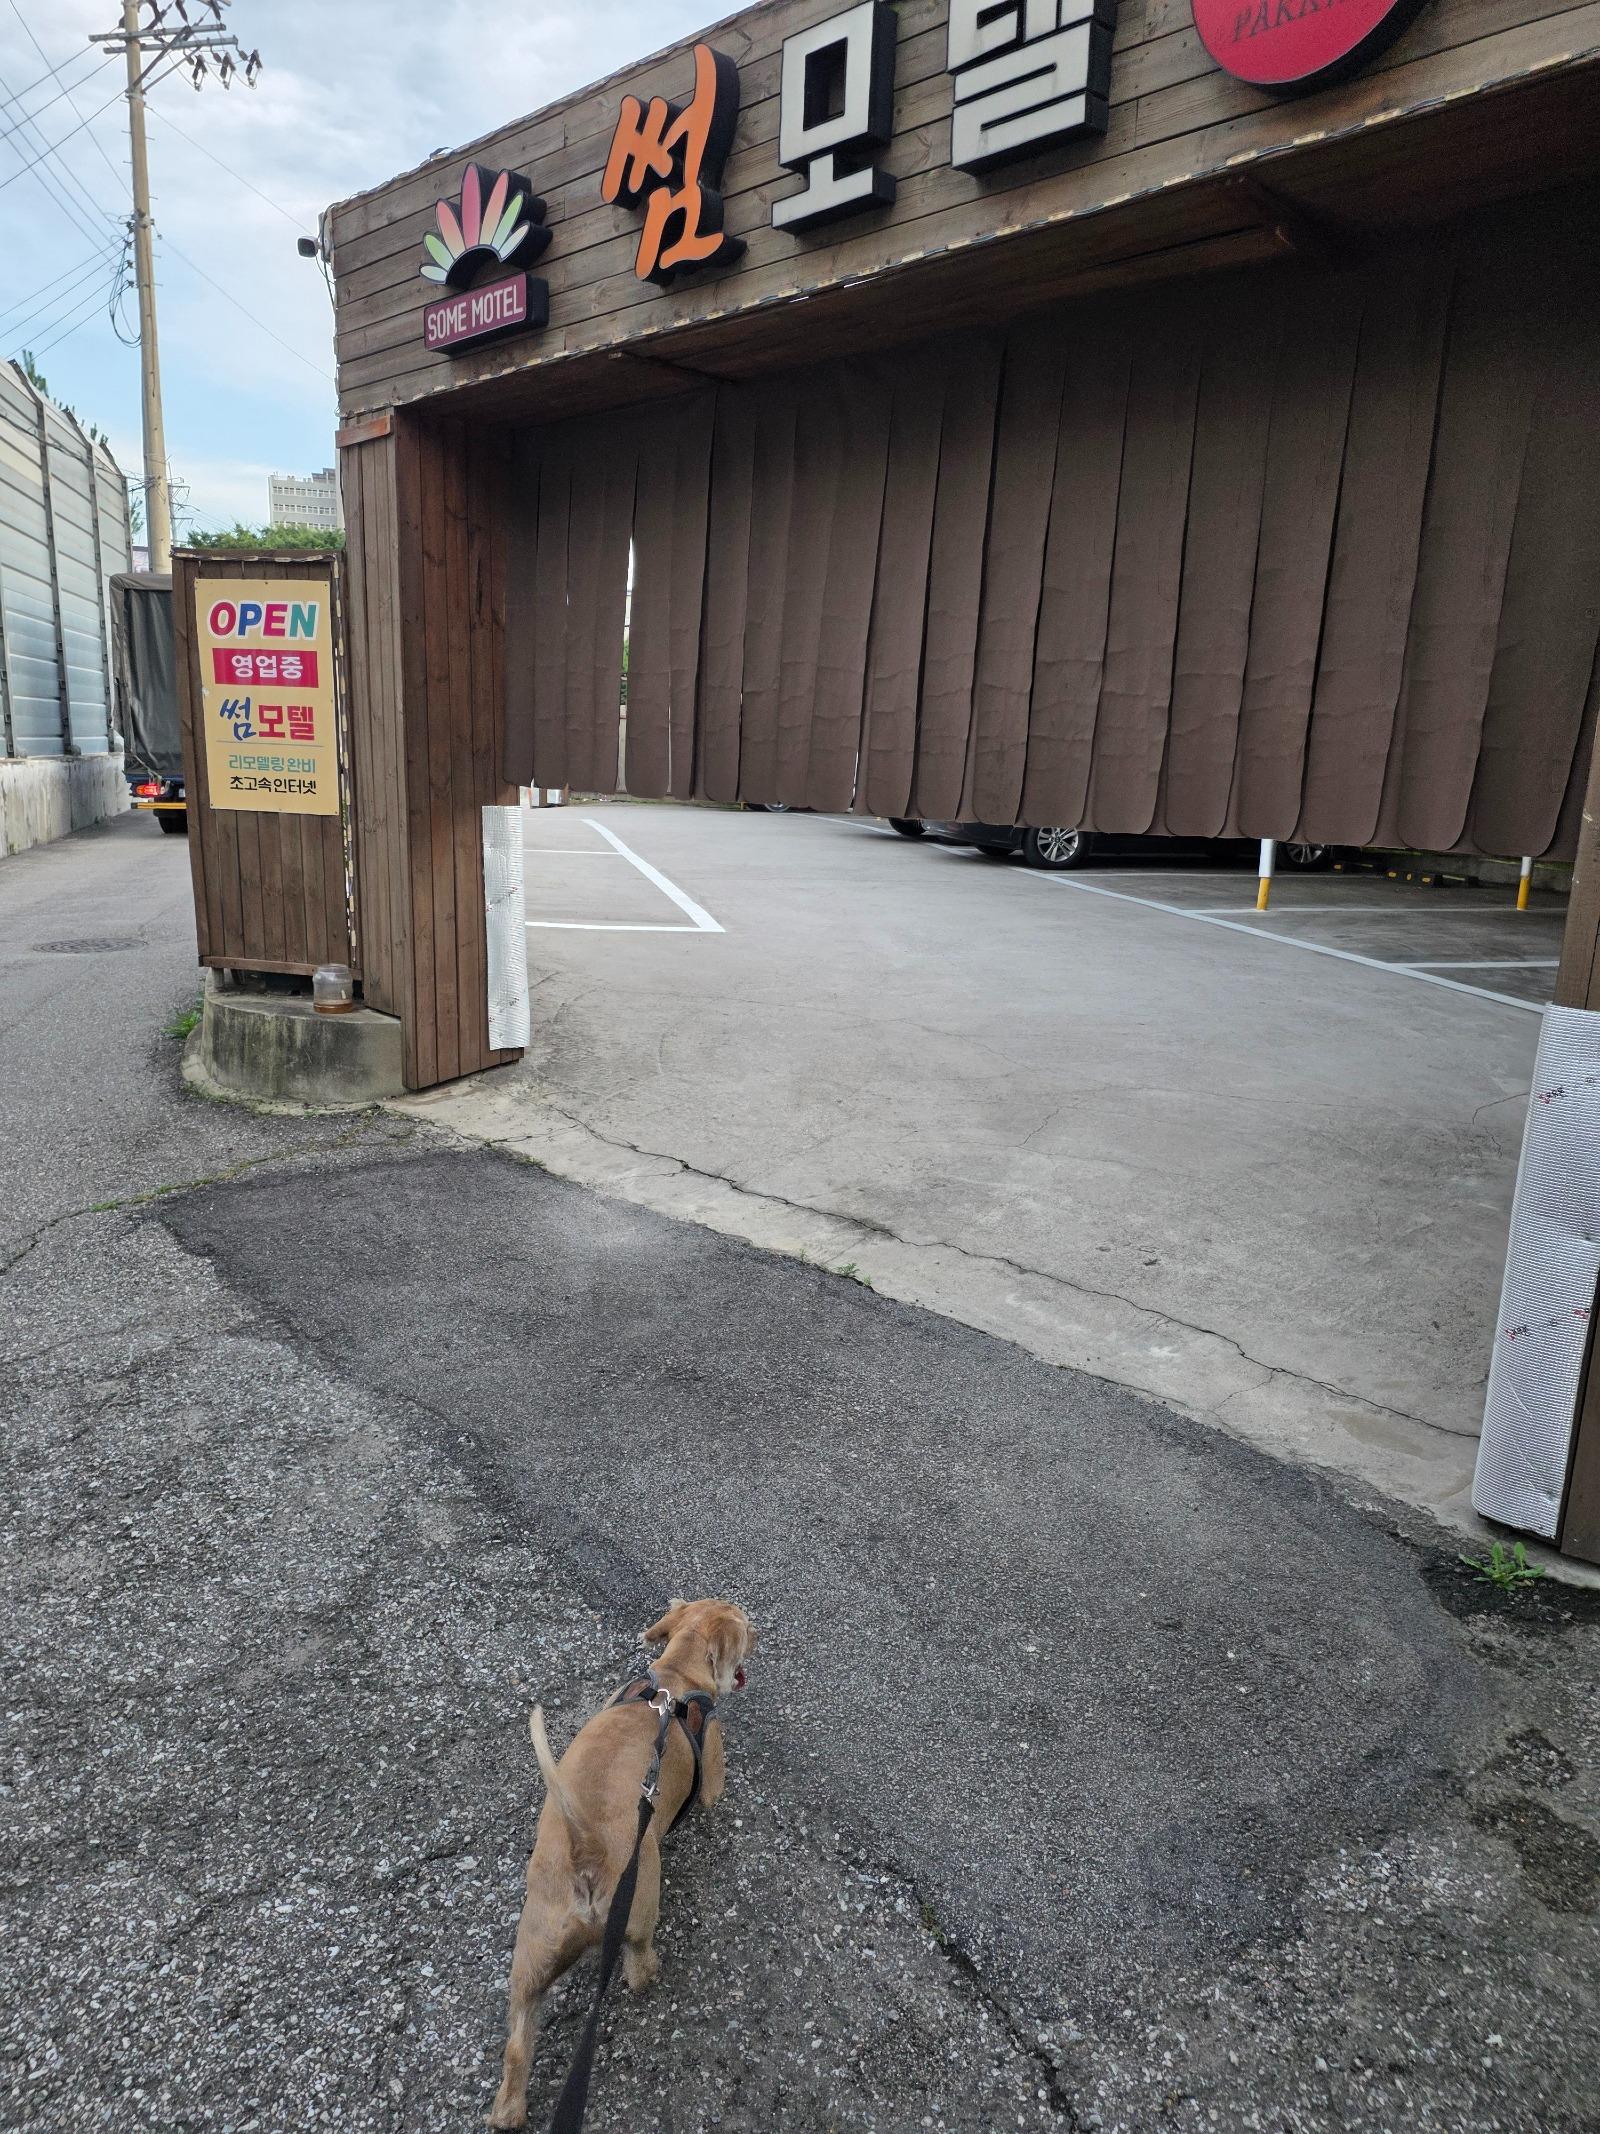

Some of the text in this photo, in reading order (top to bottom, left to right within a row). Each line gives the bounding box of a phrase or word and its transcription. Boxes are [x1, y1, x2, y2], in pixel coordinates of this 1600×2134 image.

[427, 284, 524, 342] SOME MOTEL
[208, 601, 318, 639] OPEN
[231, 654, 304, 680] 영업중
